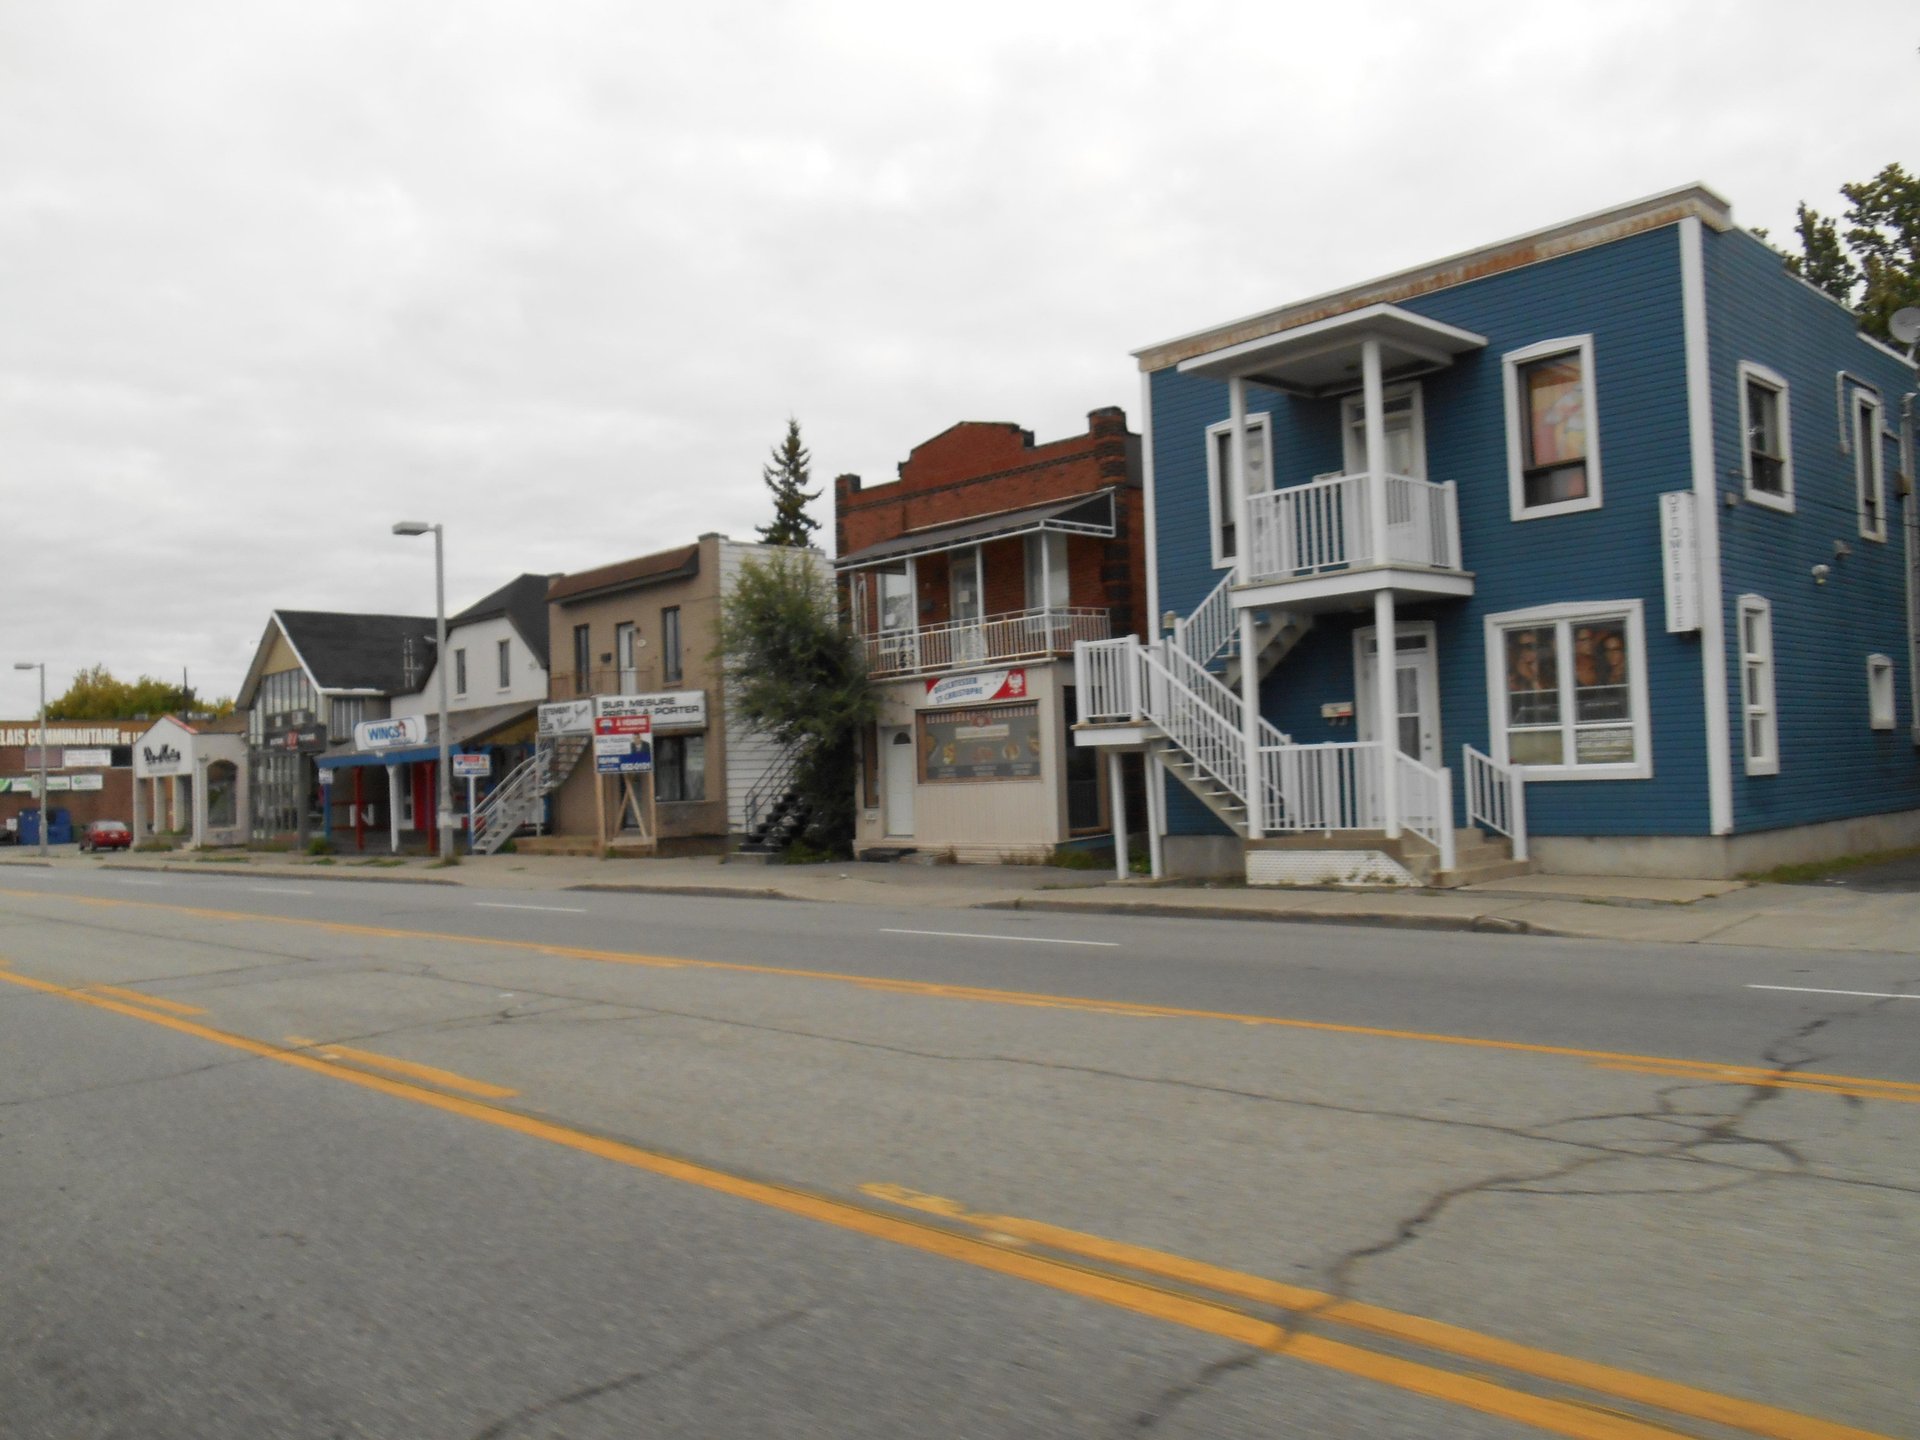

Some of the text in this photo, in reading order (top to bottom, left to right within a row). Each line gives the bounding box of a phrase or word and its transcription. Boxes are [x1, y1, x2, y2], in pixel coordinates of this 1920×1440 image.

[602, 697, 676, 709] SUR MESURE
[28, 727, 119, 746] COMMUNAUTAIRE
[367, 726, 401, 741] WINGS
